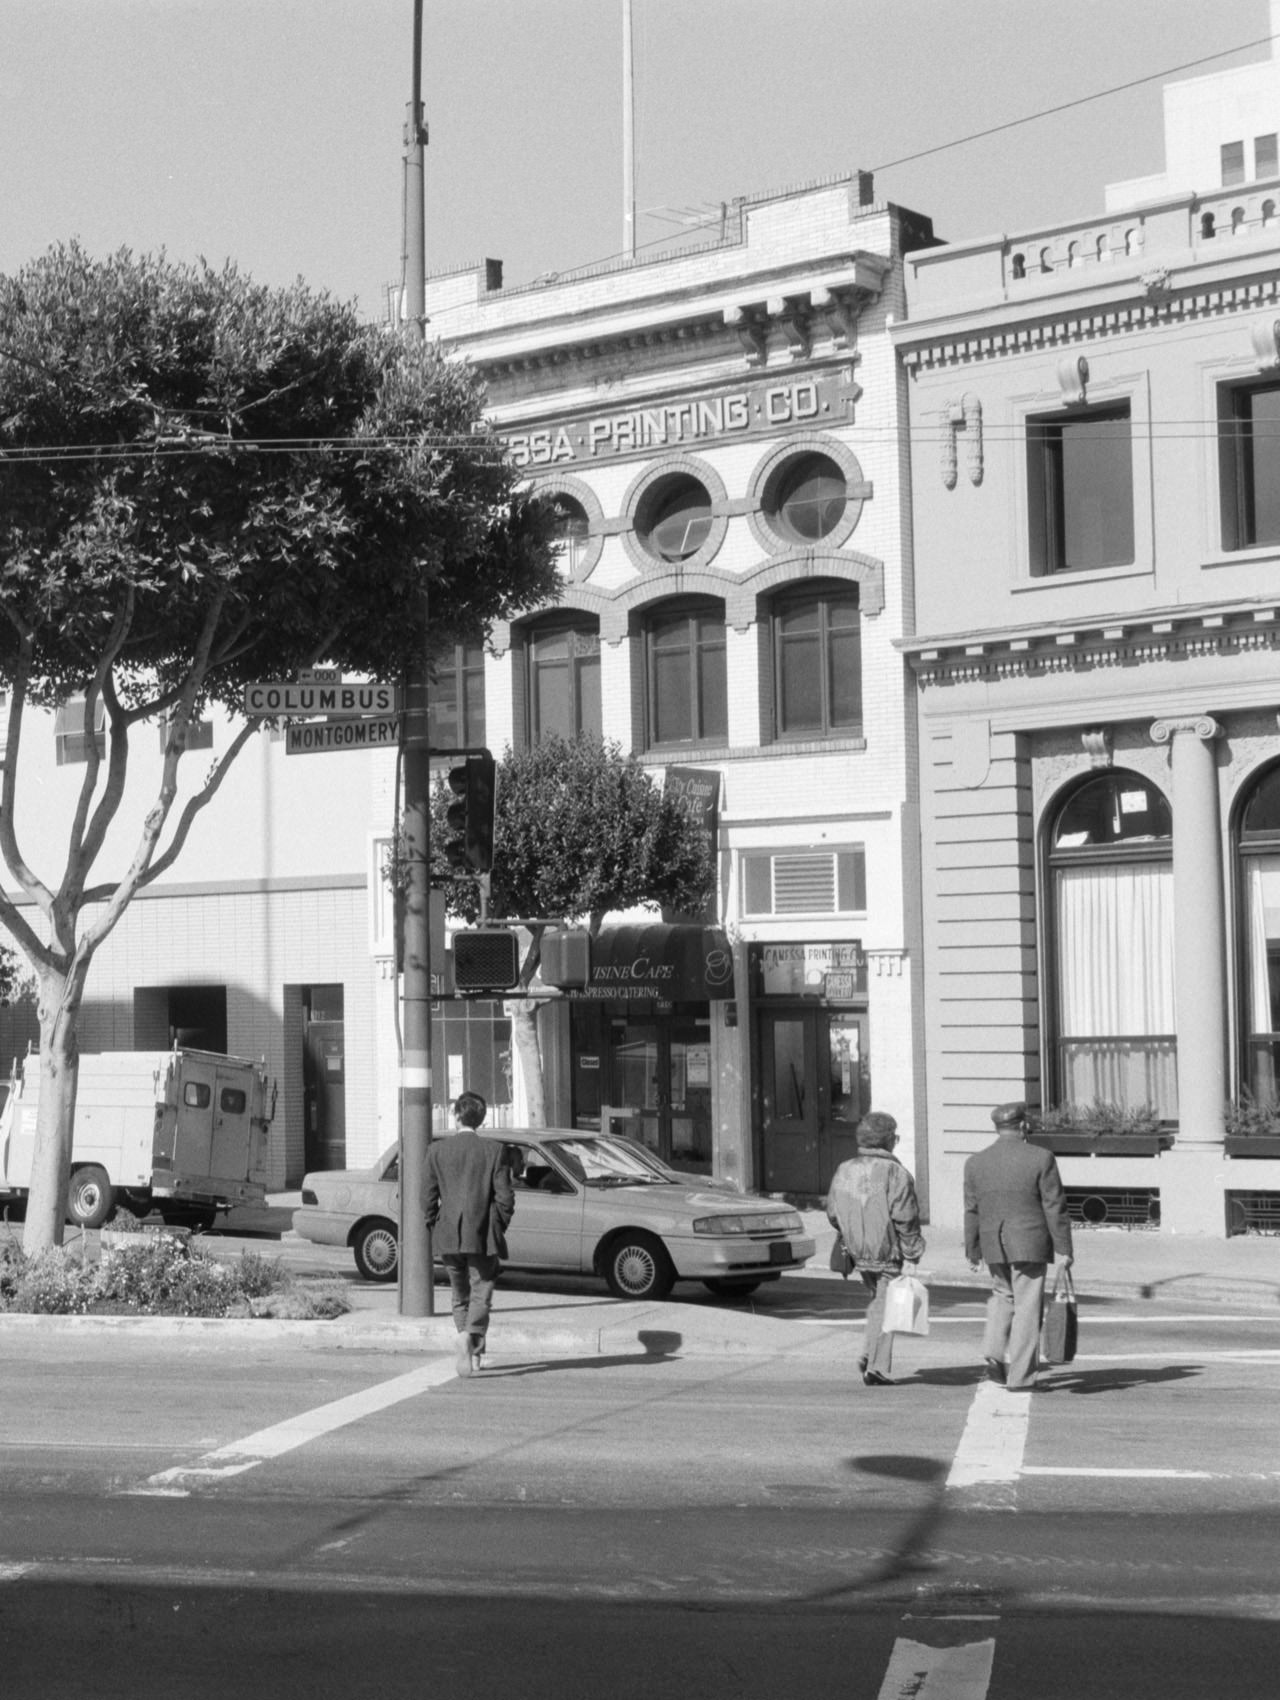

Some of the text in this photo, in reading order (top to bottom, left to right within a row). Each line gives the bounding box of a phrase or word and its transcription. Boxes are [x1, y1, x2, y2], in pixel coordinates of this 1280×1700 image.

[500, 381, 830, 468] SSA PRINTING CO.
[313, 670, 337, 682] 000
[250, 689, 391, 710] COLUMBUS
[290, 720, 399, 749] MONTGOMERY
[808, 948, 848, 961] PRINTING
